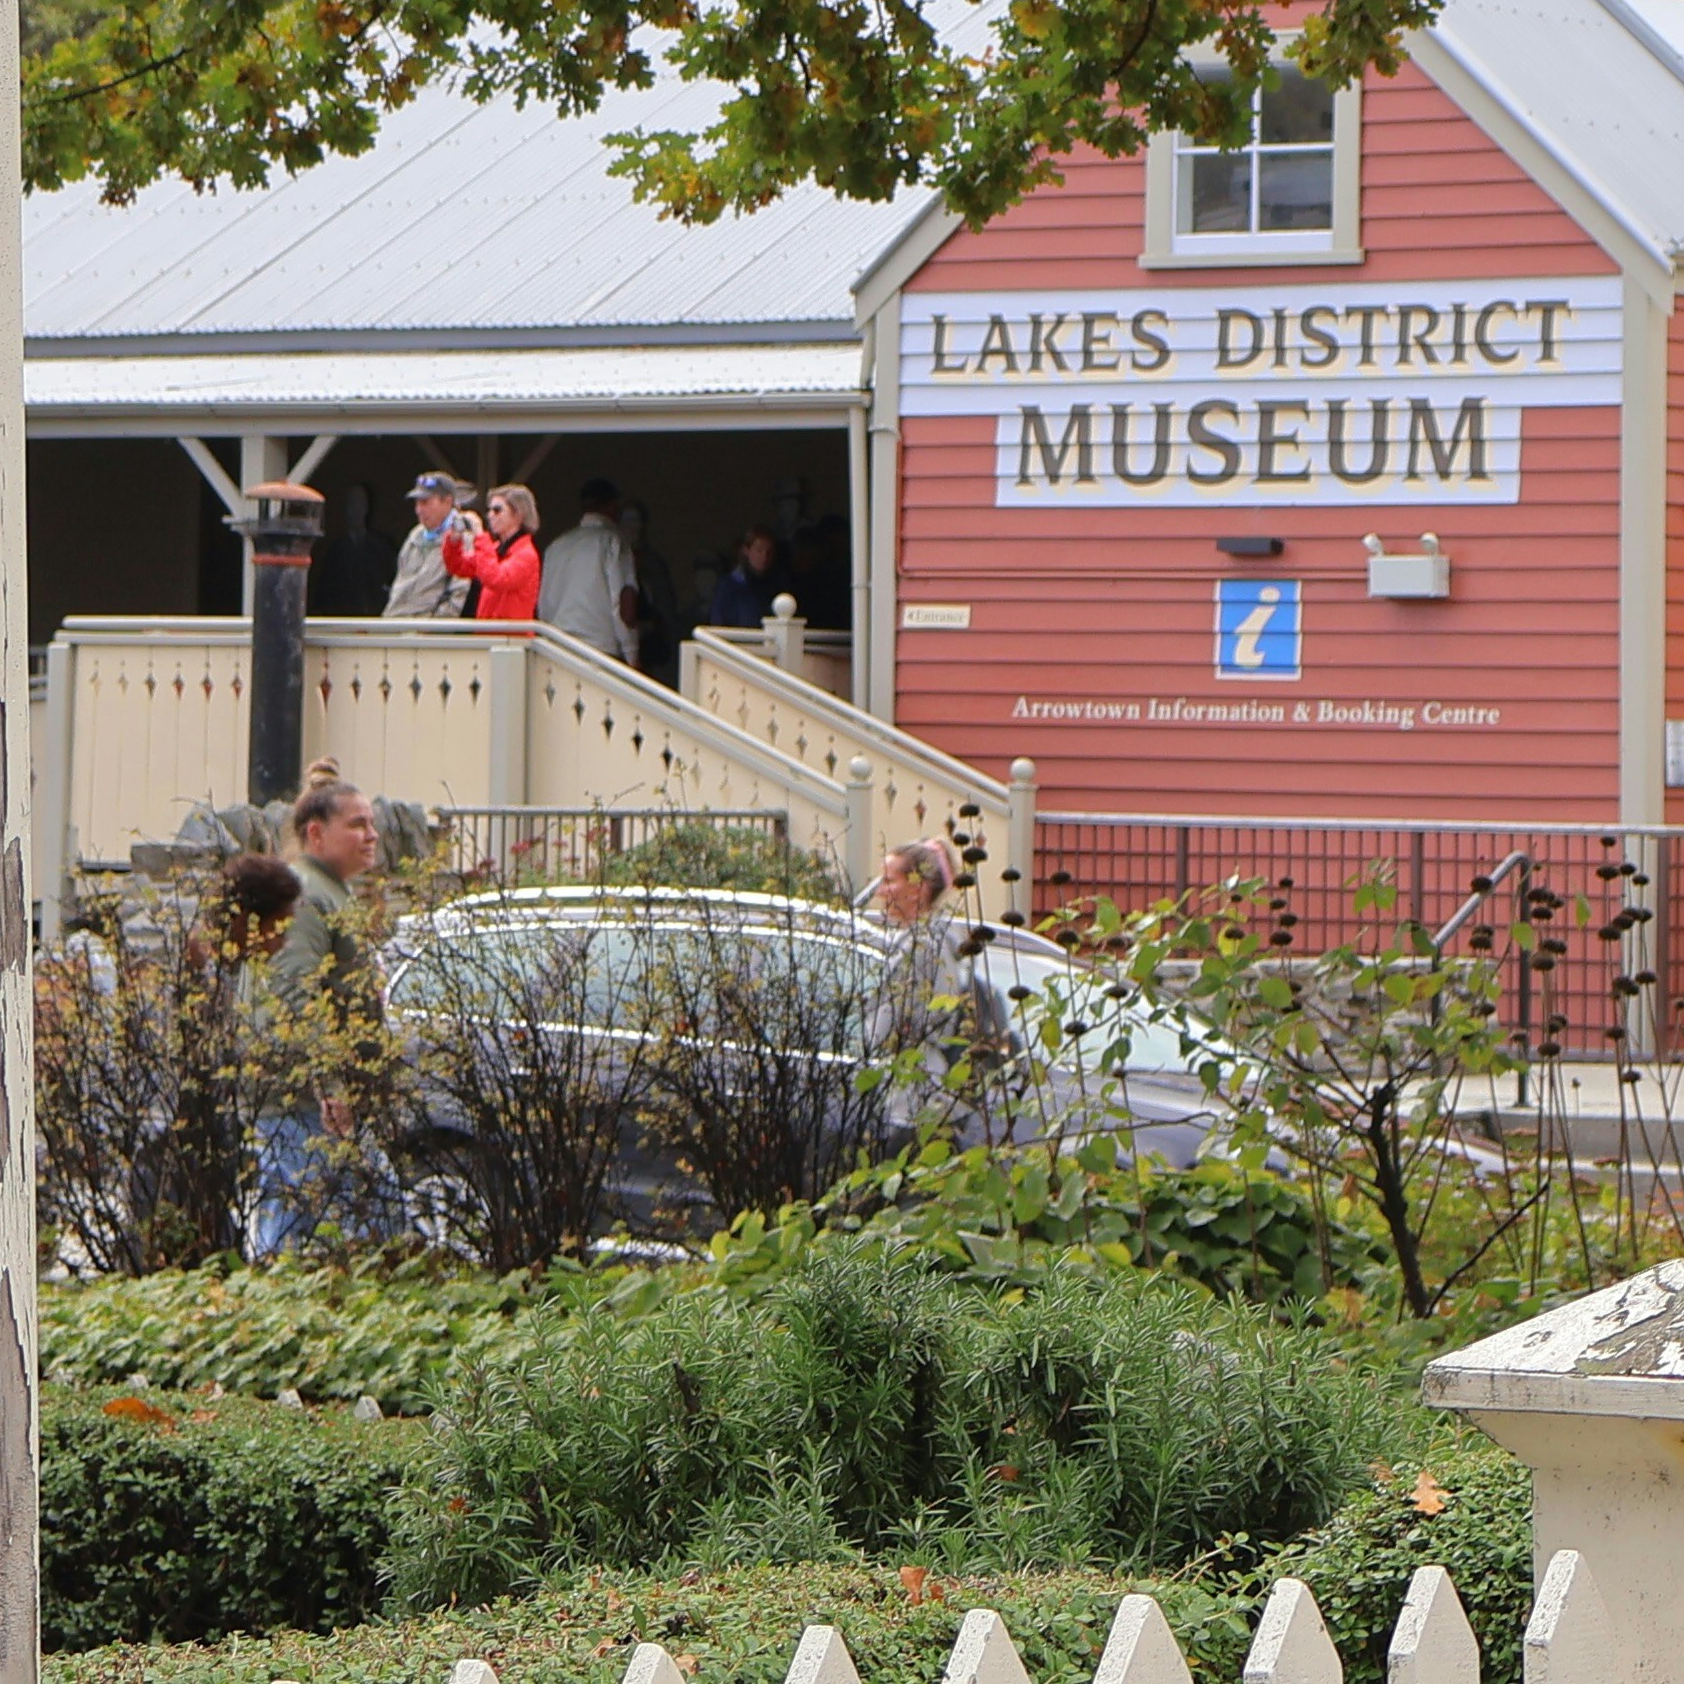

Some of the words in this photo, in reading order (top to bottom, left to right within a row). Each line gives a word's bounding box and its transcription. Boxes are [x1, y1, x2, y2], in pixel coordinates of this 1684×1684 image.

[928, 308, 1172, 376] LAKES
[1213, 298, 1572, 372] DISTRICT
[1015, 395, 1495, 488] MUSEUM
[1012, 694, 1141, 720] Arrowtown
[1147, 696, 1285, 722] Information
[1292, 701, 1312, 722] &
[1316, 700, 1415, 730] Booking
[1421, 701, 1501, 725] Centre
